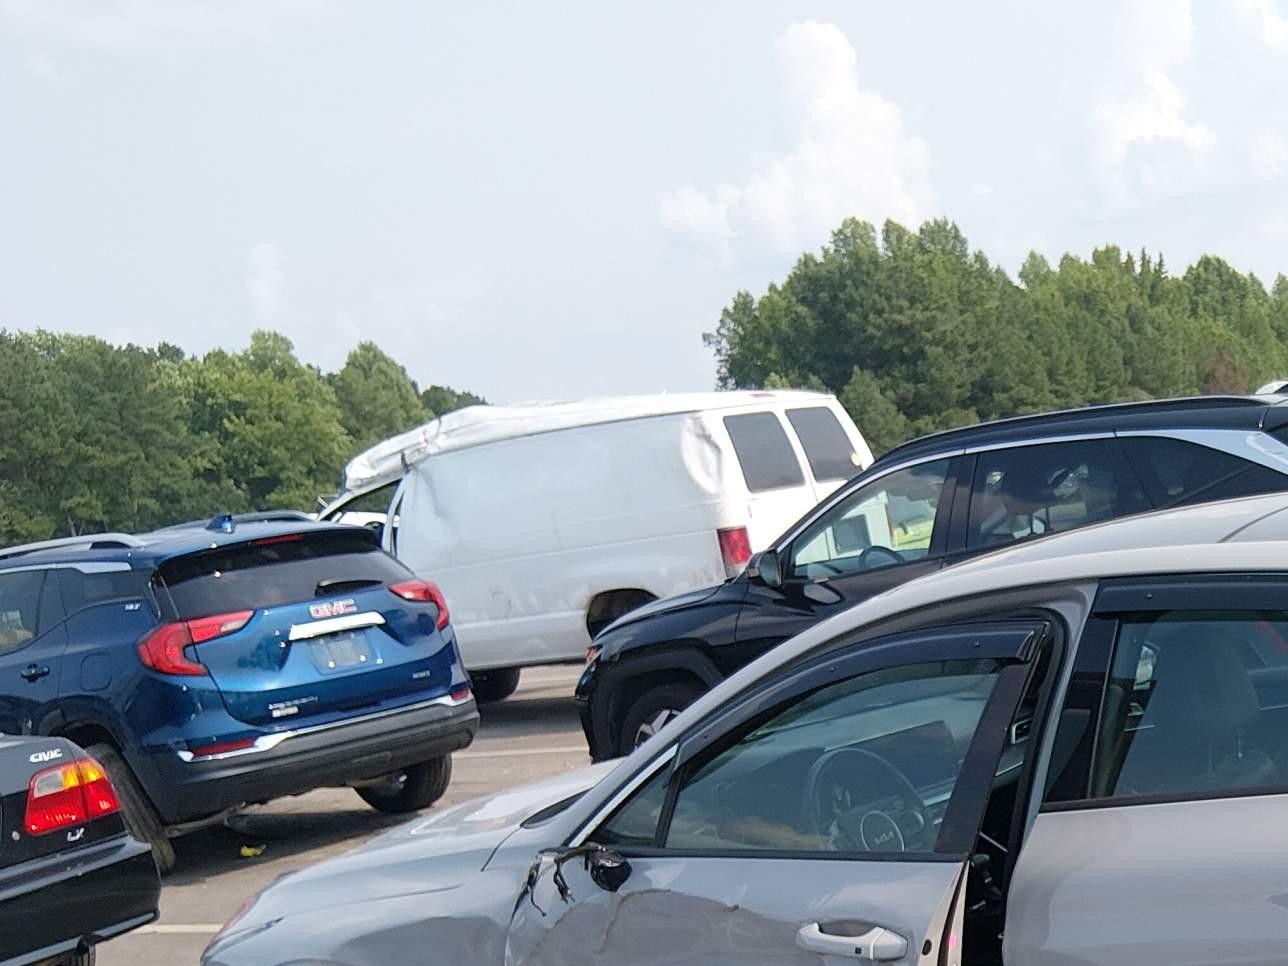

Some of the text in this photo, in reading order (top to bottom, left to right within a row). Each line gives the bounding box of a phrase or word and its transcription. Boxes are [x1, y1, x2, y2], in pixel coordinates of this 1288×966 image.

[309, 598, 358, 619] GMC
[29, 748, 63, 763] CIVIC
[66, 827, 85, 842] LX
